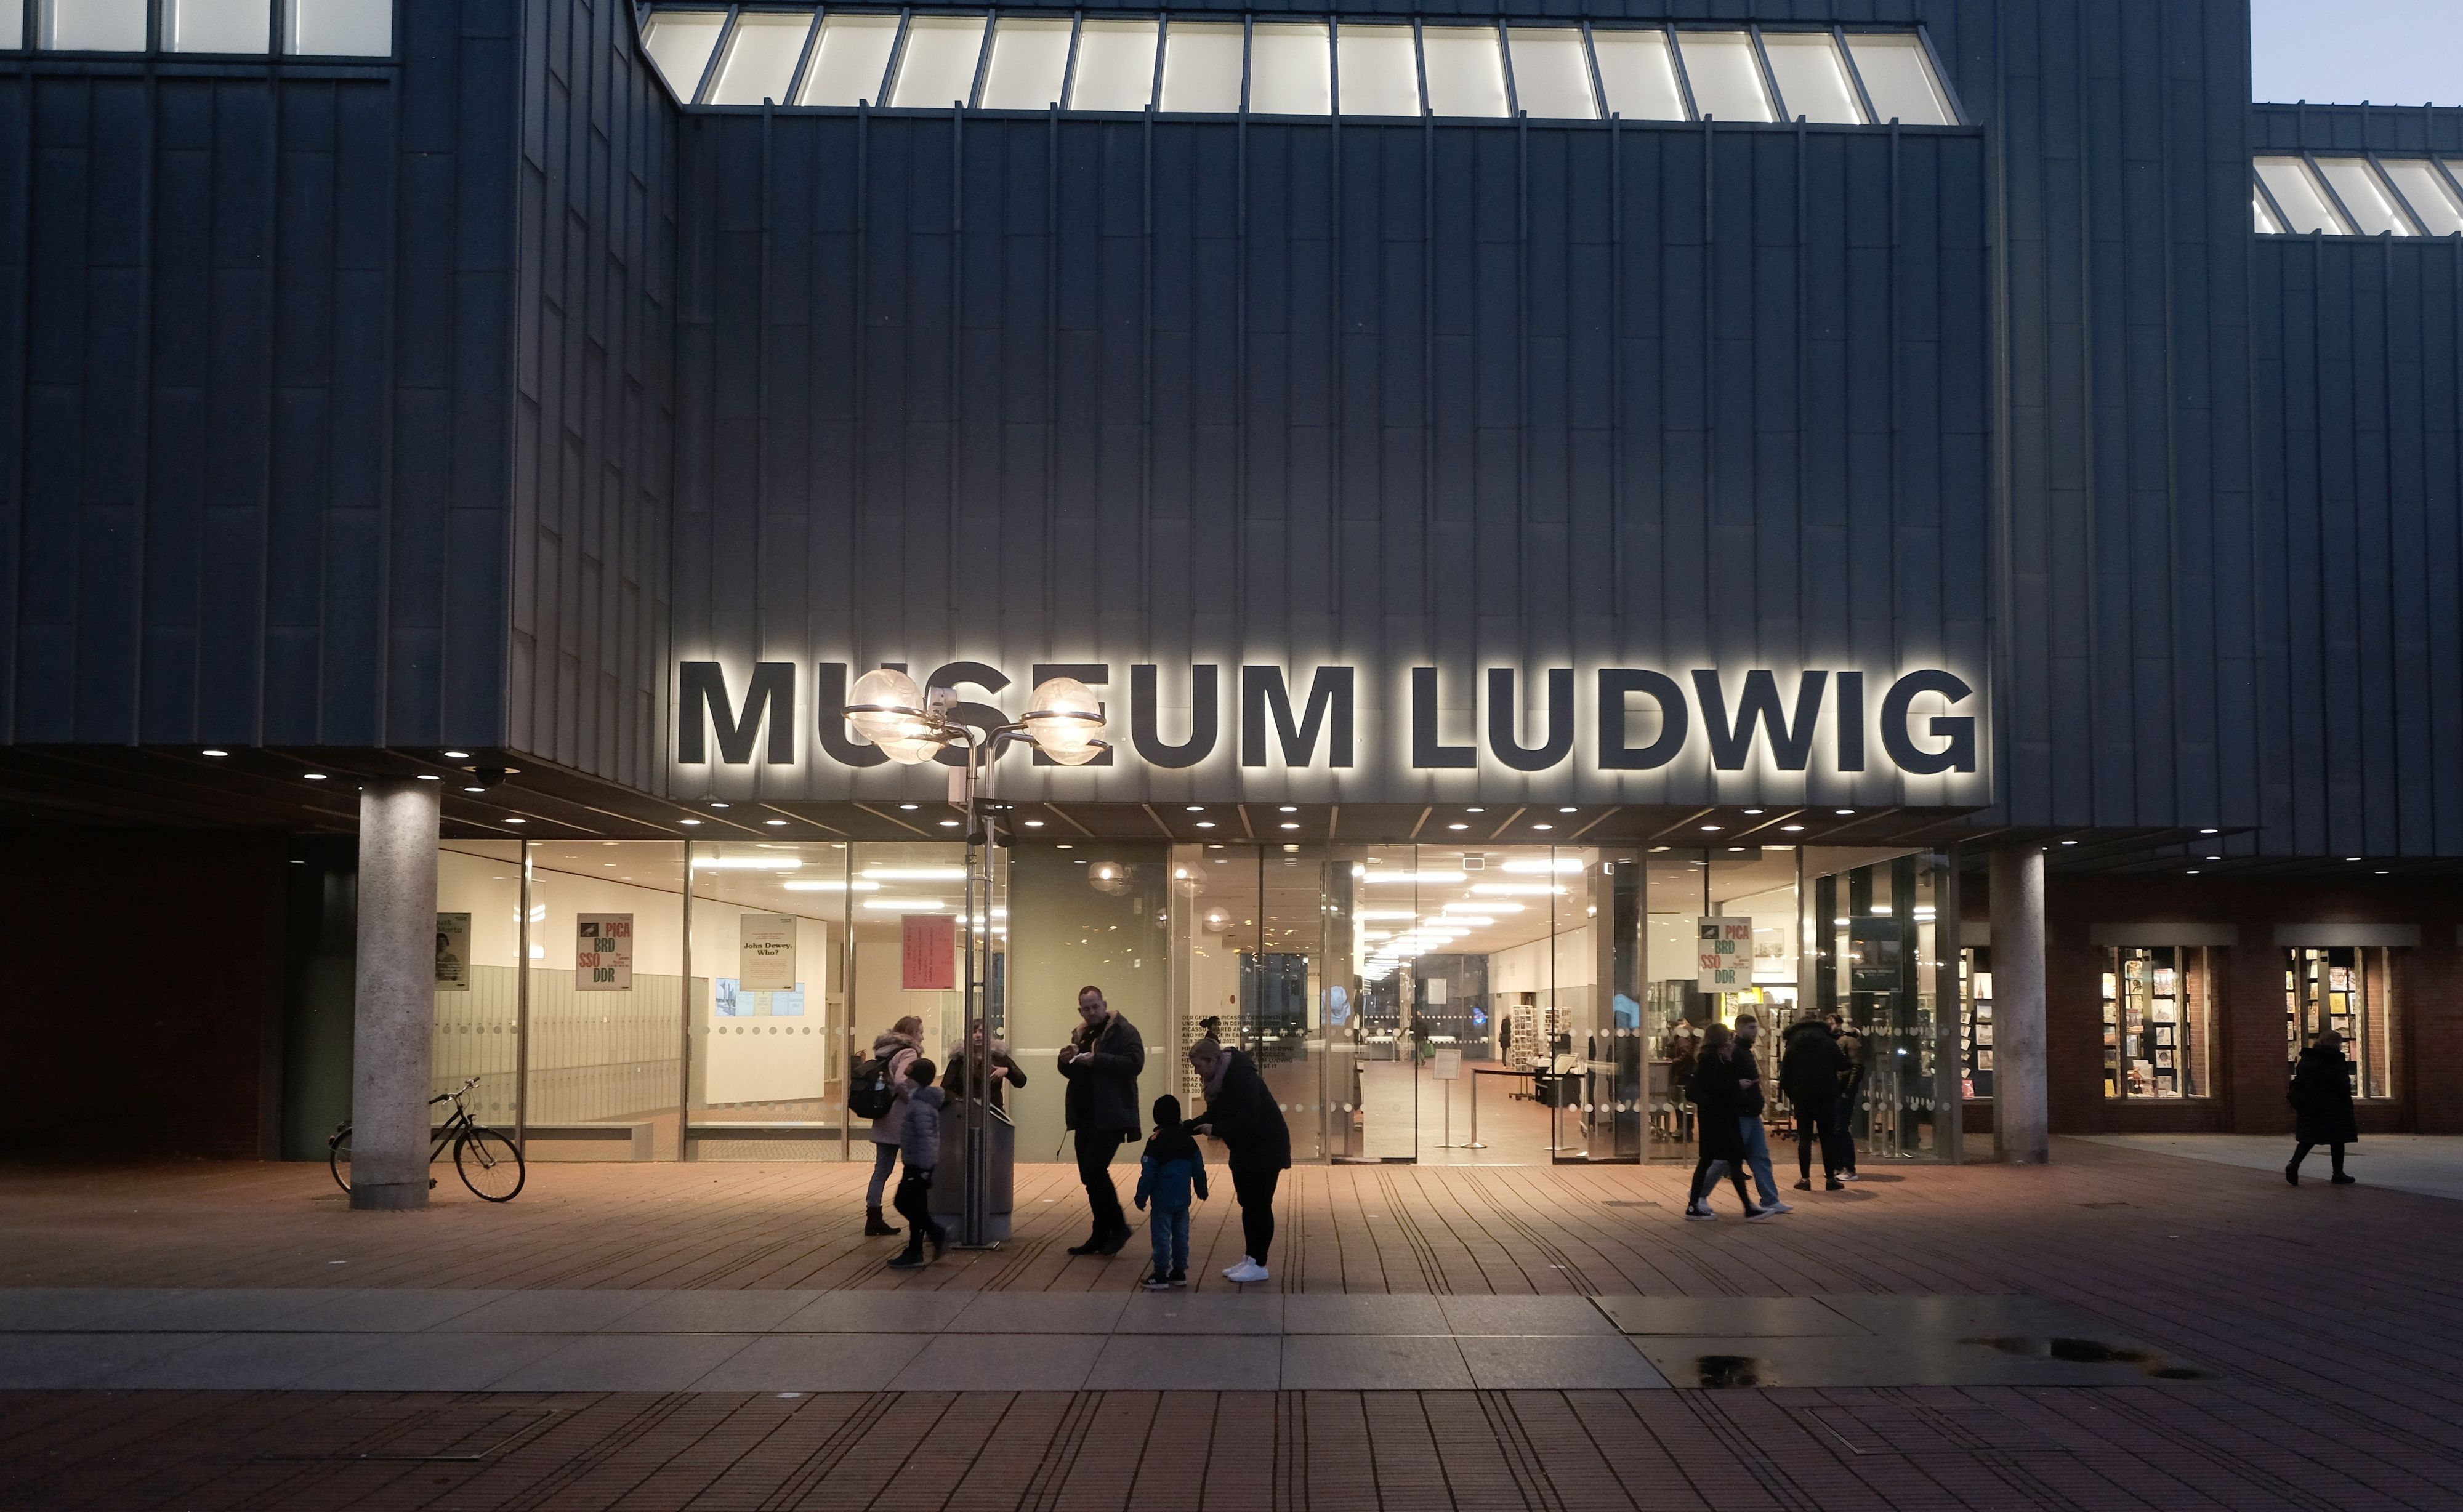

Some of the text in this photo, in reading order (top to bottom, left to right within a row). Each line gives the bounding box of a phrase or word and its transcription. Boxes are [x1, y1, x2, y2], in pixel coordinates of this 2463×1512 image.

[1413, 667, 1975, 774] LUDWIG
[605, 922, 631, 937] PICA
[1725, 925, 1749, 939] PICA
[594, 938, 615, 952] BRD
[1715, 940, 1735, 954] BRD
[579, 952, 600, 967] SSO
[1701, 954, 1721, 969] SSO
[593, 968, 615, 982] DDR
[1715, 970, 1735, 984] DDR
